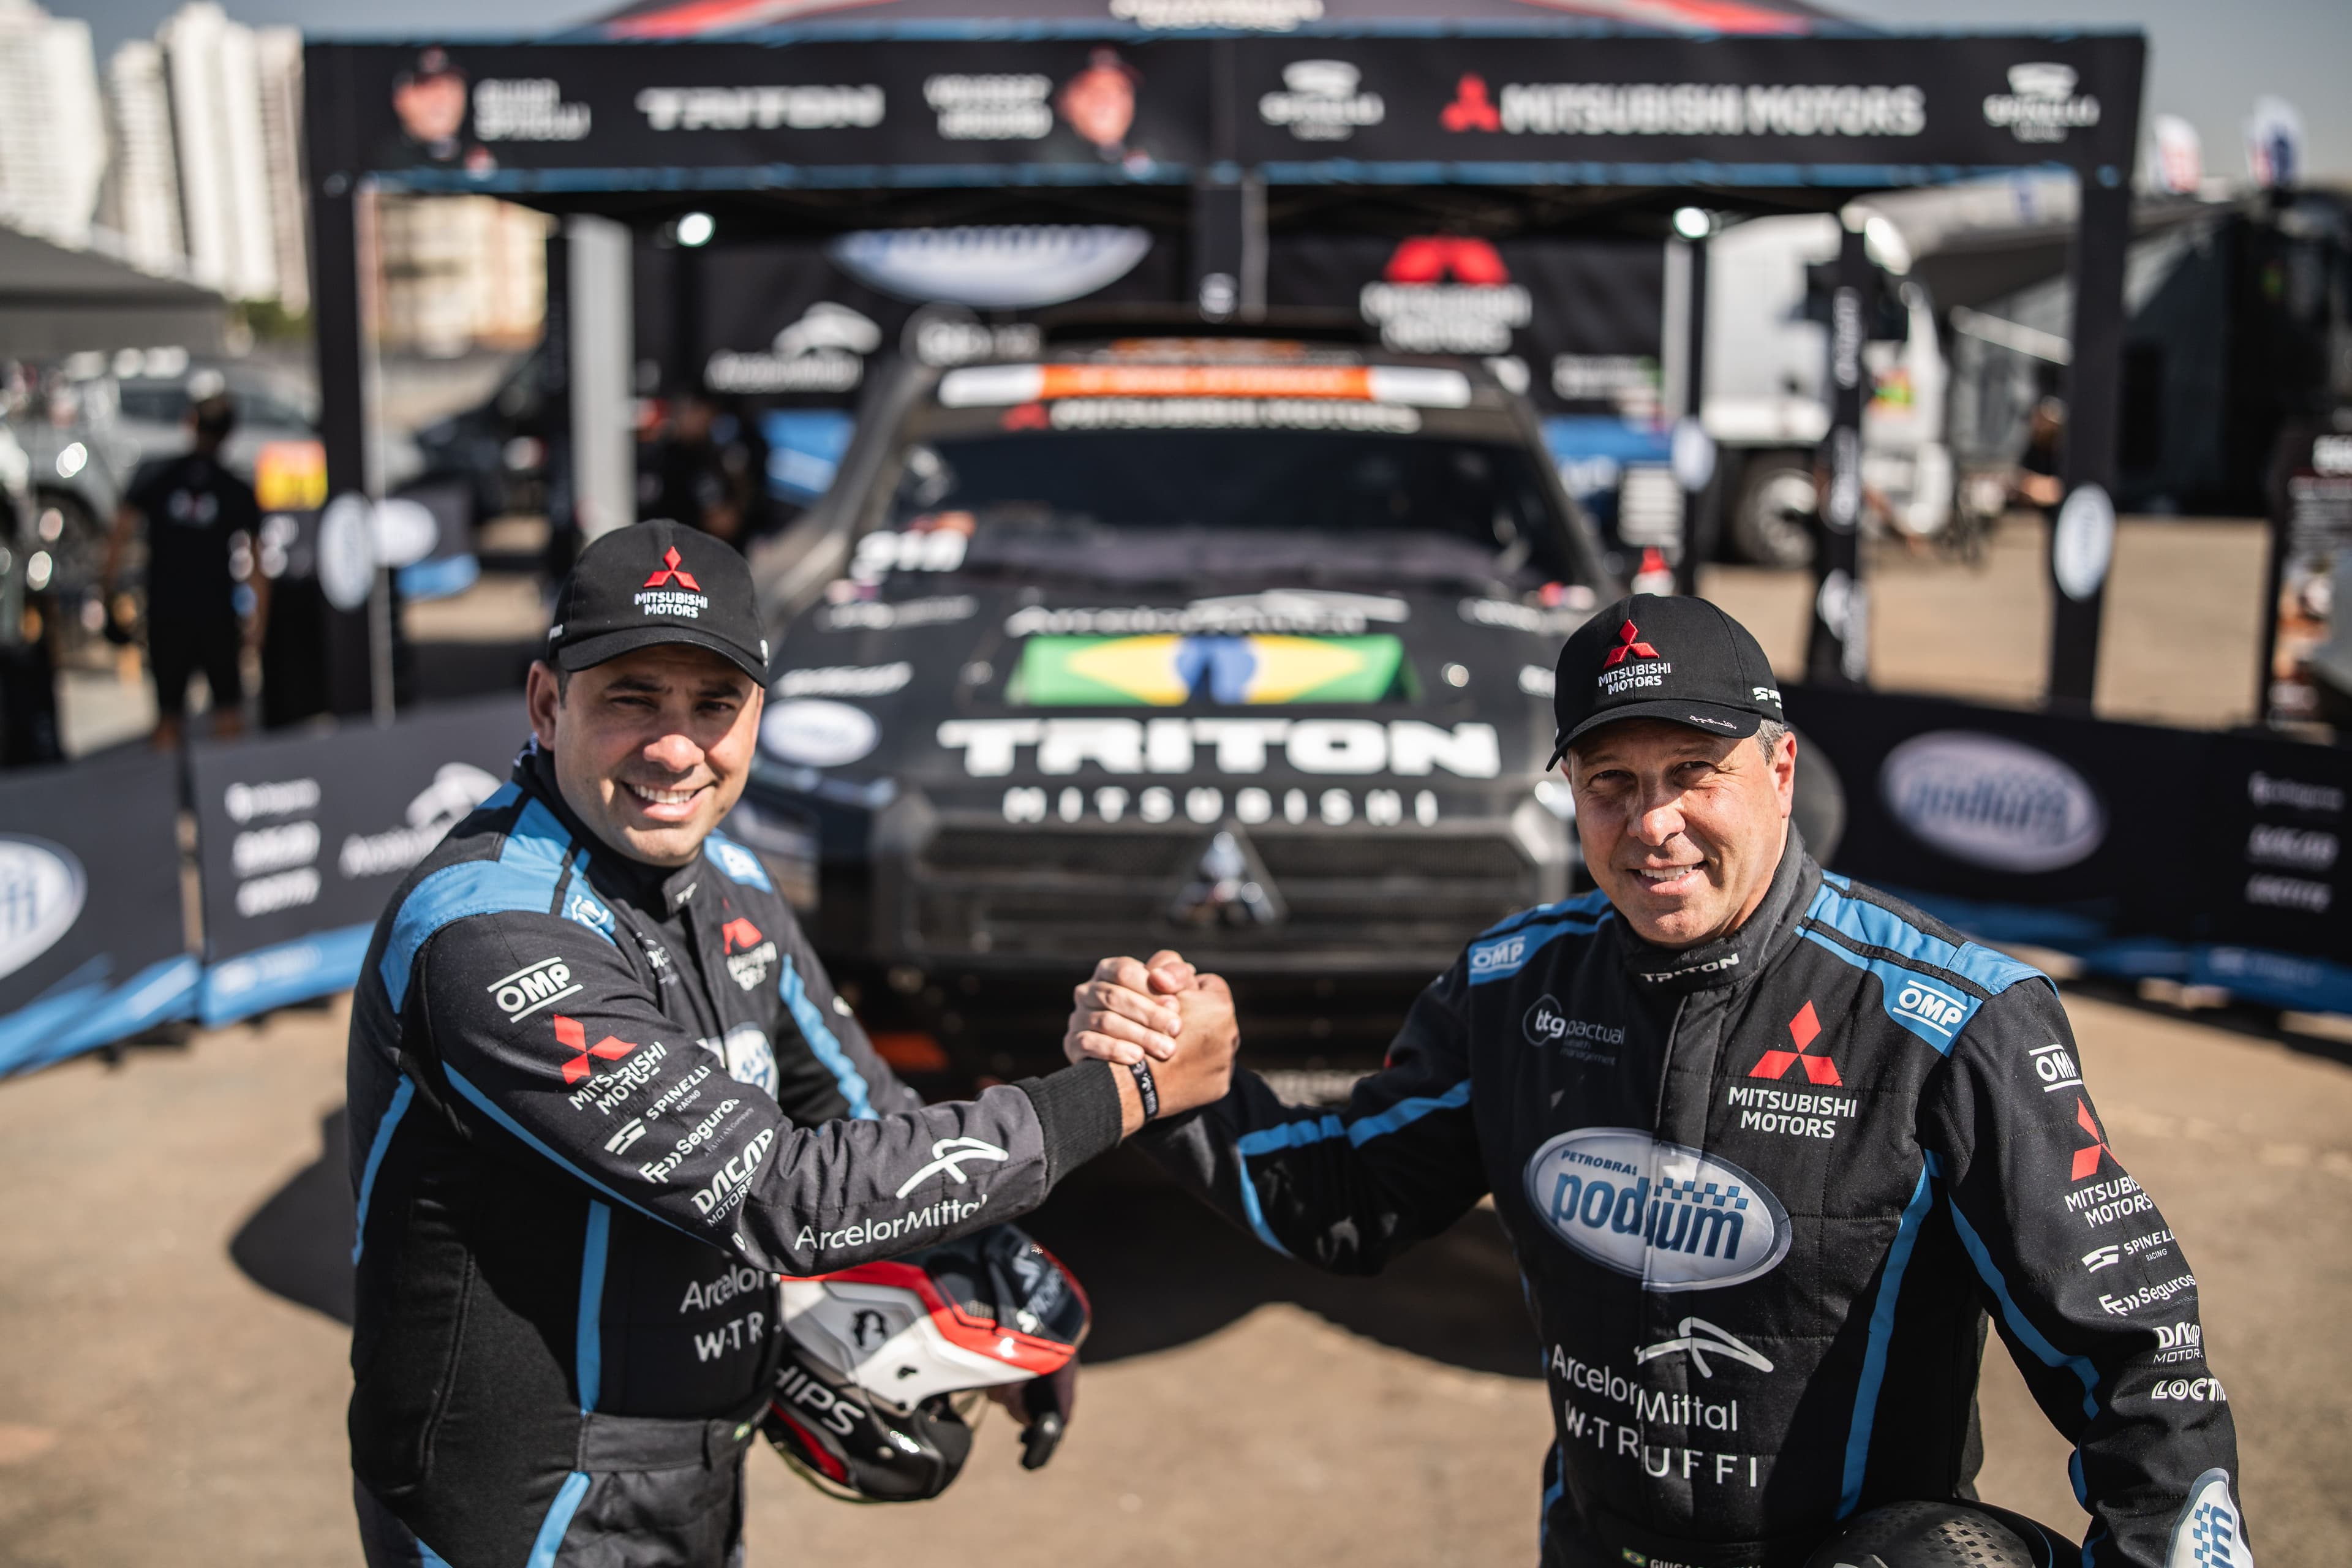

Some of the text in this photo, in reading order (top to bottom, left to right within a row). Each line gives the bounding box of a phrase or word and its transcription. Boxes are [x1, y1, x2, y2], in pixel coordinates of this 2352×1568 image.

[635, 592, 708, 609] MITSUBISHI
[644, 603, 698, 619] MOTORS
[1598, 662, 1672, 687] MITSUBISHI
[1608, 675, 1663, 695] MOTORS
[937, 717, 1501, 778] TRITON
[1002, 785, 1438, 826] MITSUBISHI
[1472, 943, 1525, 969] OMP
[497, 963, 571, 1012] OMP
[1899, 988, 1962, 1027] OMP
[646, 1065, 711, 1120] SPINELLI
[1728, 1087, 1858, 1118] MITSUBISHI
[676, 1098, 741, 1156] Seguros
[1740, 1110, 1836, 1140] MOTORS
[2064, 1175, 2142, 1213] MITSUBI
[1551, 1172, 1744, 1261] podium
[2084, 1192, 2153, 1228] MOTORS
[2124, 1228, 2175, 1256] SPINELL
[2146, 1248, 2168, 1262] RACING
[679, 1263, 765, 1314] Arcelor
[2138, 1274, 2196, 1304] Seguros
[2153, 1348, 2204, 1364] MOTOR
[1551, 1343, 1738, 1431] ArcelorMittal
[2151, 1377, 2227, 1402] LOCT
